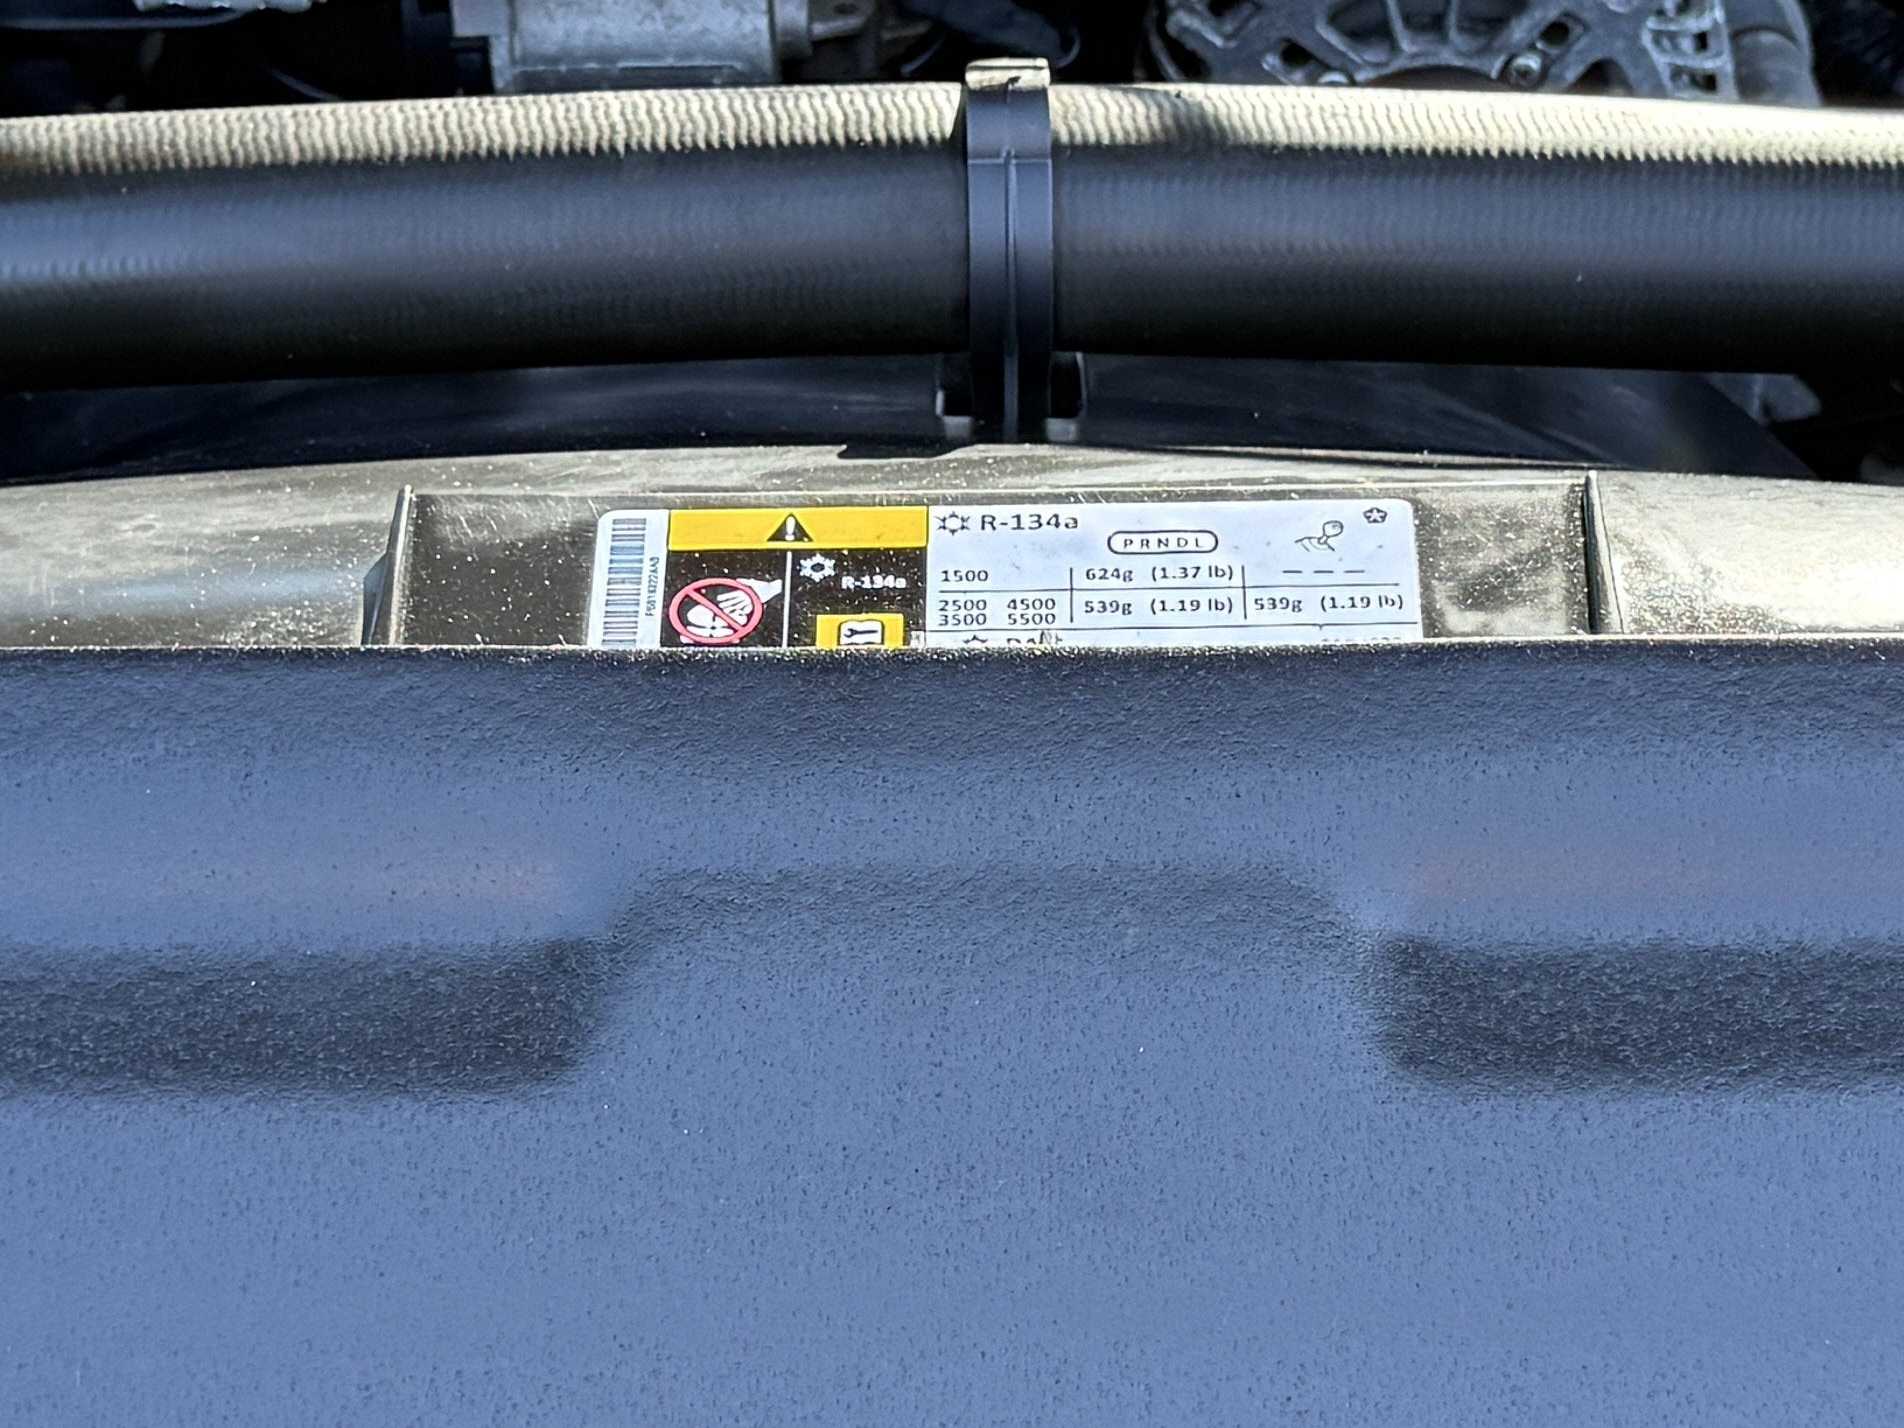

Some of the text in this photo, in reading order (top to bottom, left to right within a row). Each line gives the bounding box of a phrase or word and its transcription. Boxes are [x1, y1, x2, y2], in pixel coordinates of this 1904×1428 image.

[980, 513, 1079, 532] R-134a
[841, 574, 908, 589] R-134a
[940, 564, 1234, 583] 1500 624g (1.37 lb)
[938, 593, 1404, 616] 2500 4500 539g (1.19 lb) 539g (1.19 lb)
[938, 612, 1057, 627] 3500 5500
